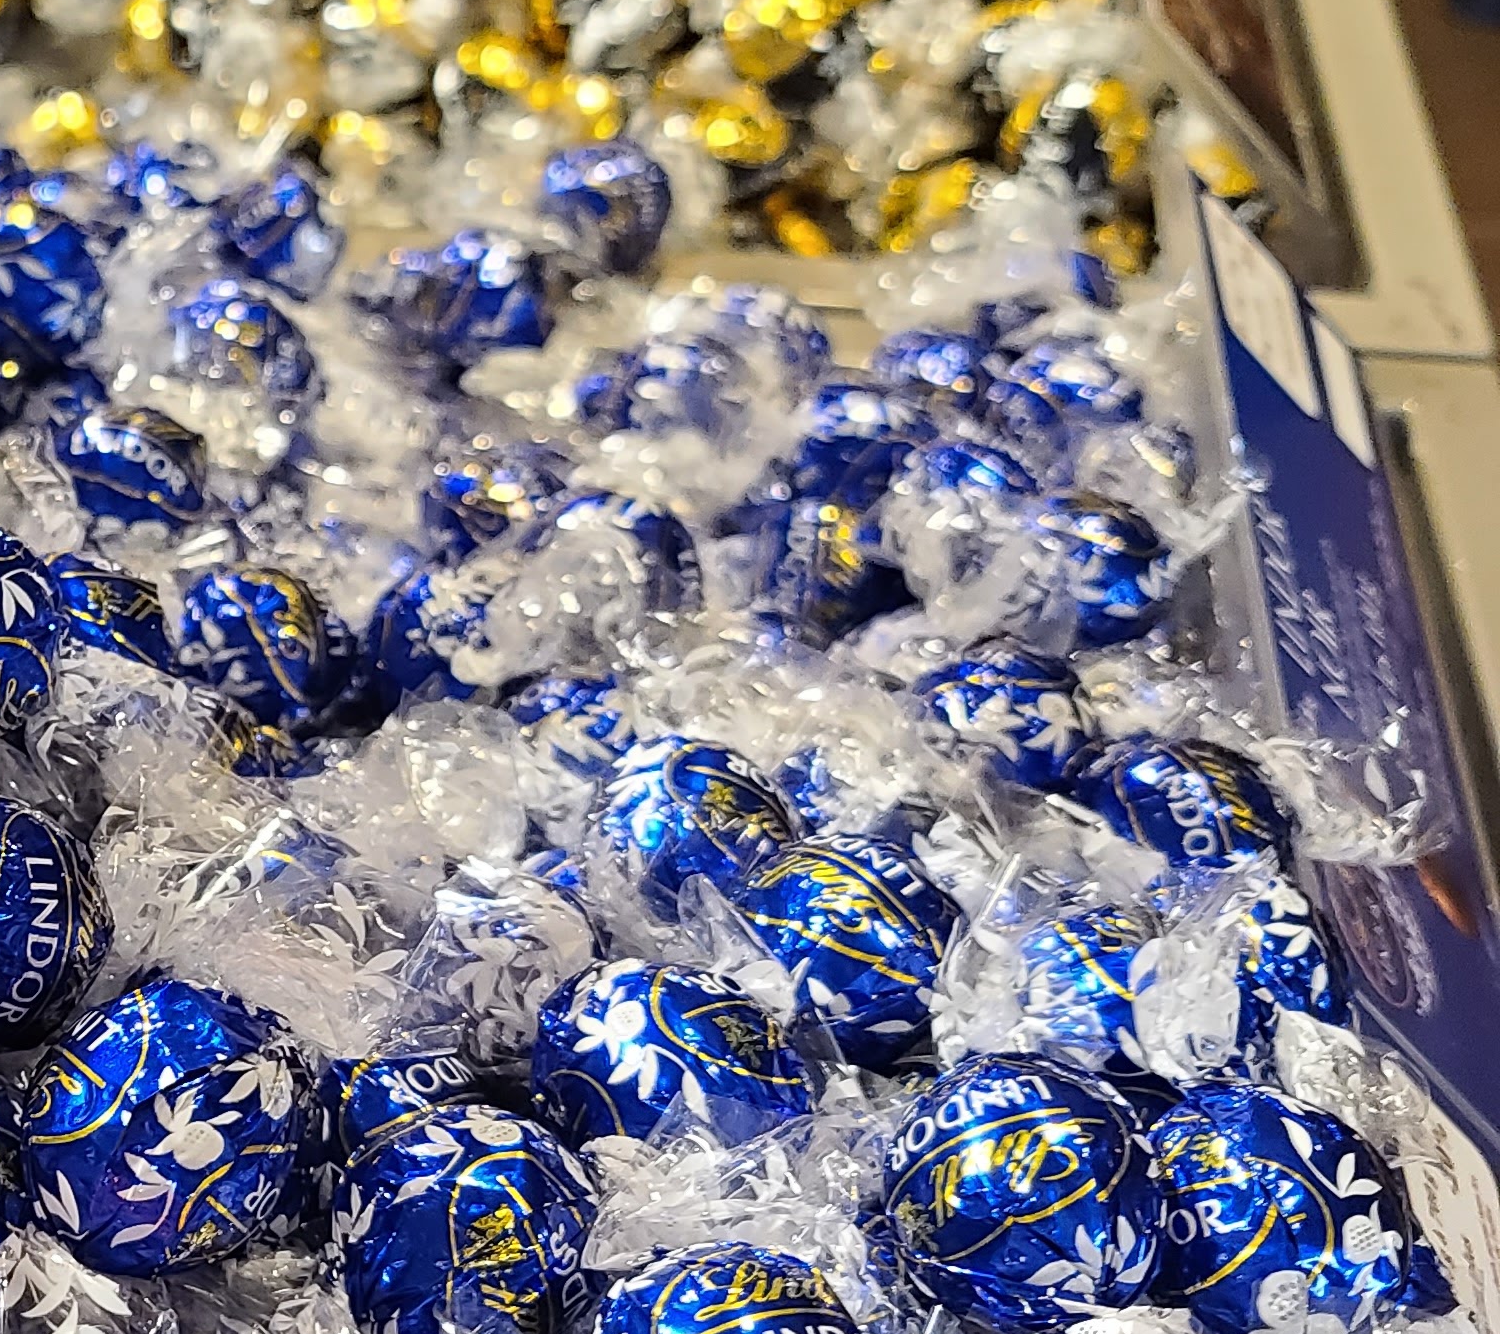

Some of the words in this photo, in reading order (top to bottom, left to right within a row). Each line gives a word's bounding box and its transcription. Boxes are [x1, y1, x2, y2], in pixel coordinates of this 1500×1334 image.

[1136, 752, 1218, 858] LINDO
[803, 832, 926, 898] LIND
[72, 1009, 122, 1053] LIN
[394, 1055, 478, 1111] NDOR
[890, 1074, 1057, 1170] LINDOR
[932, 1117, 1108, 1227] Lindt
[694, 1261, 834, 1323] Lind
